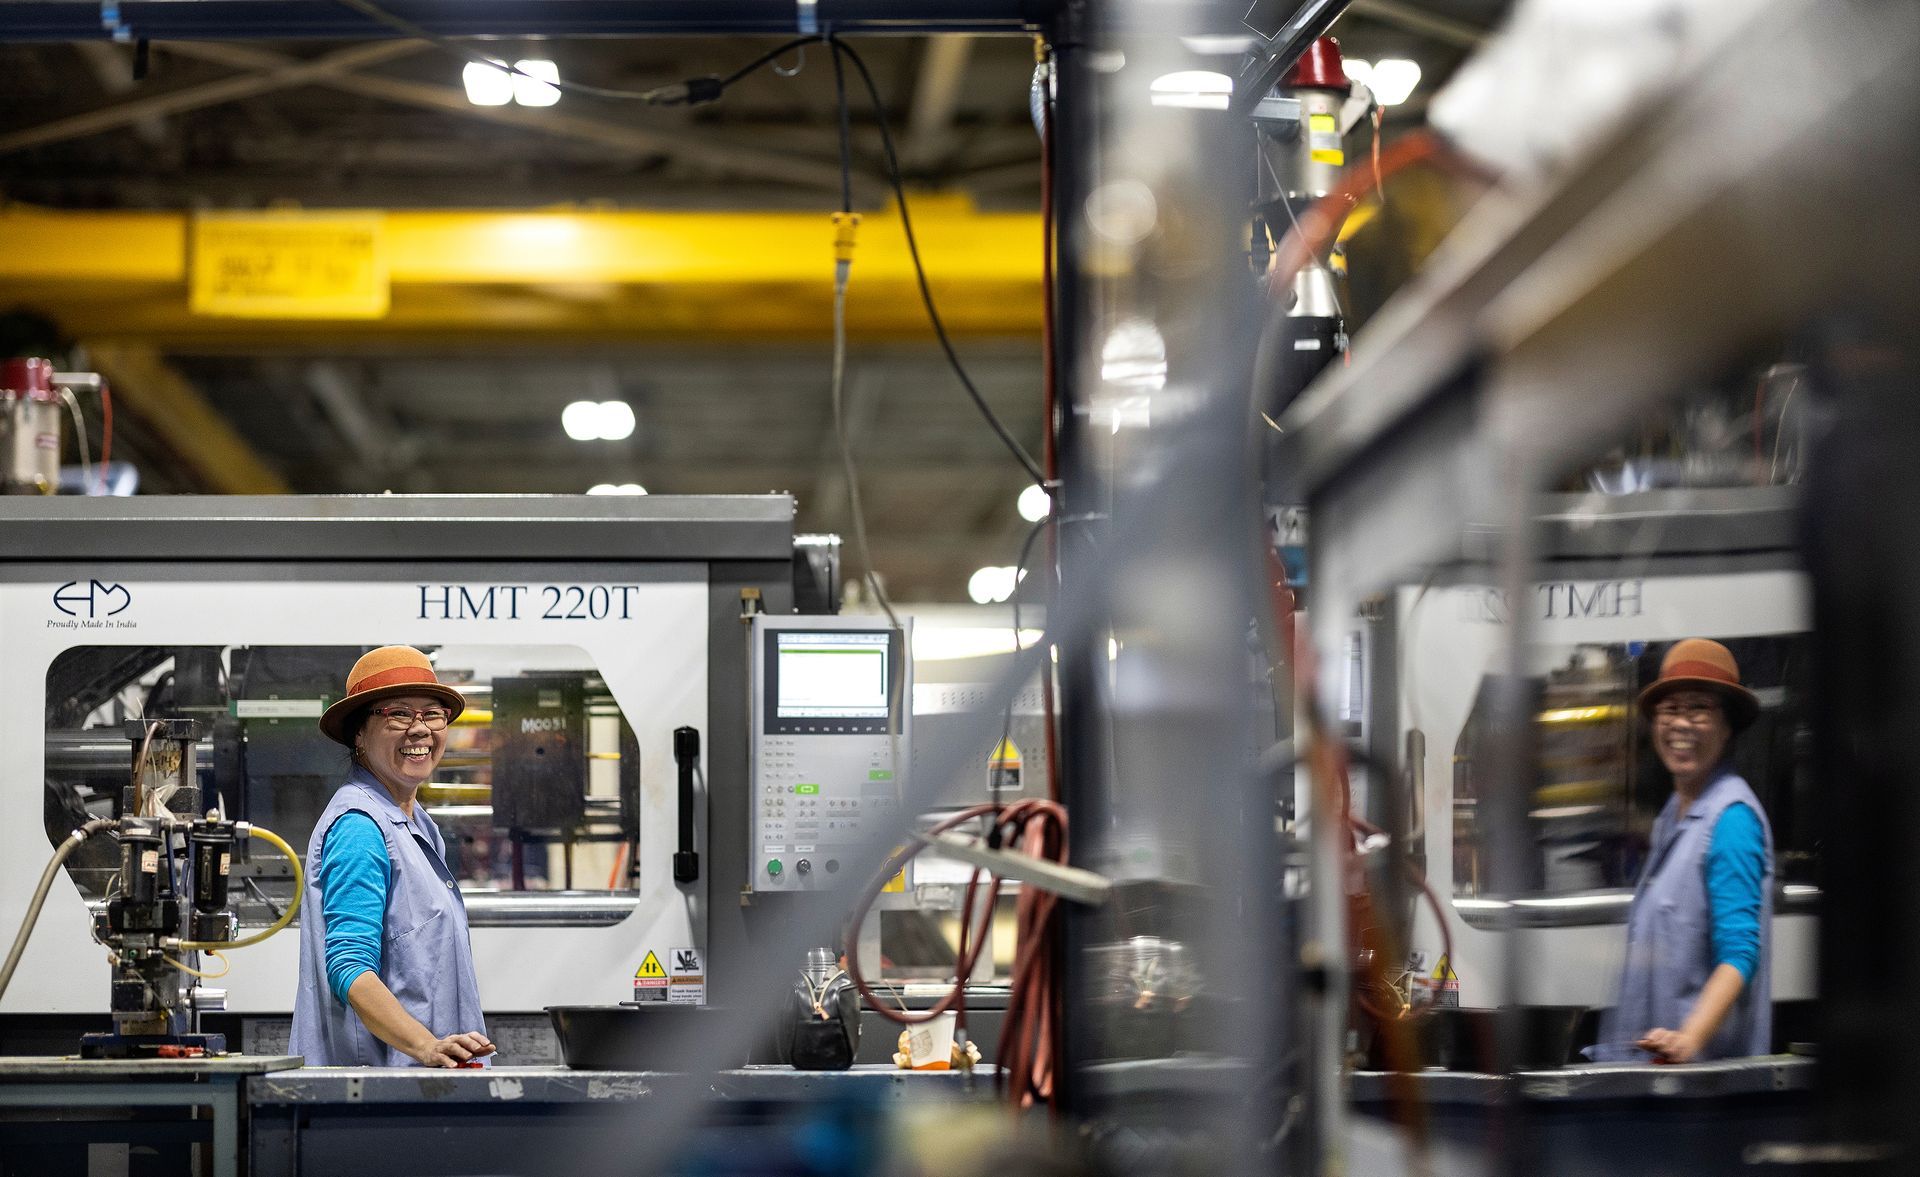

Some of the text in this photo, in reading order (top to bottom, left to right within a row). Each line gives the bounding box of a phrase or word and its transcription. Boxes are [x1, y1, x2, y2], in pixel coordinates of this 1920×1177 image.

[416, 584, 640, 621] HMT 220T
[46, 620, 137, 630] Proudly Made In India
